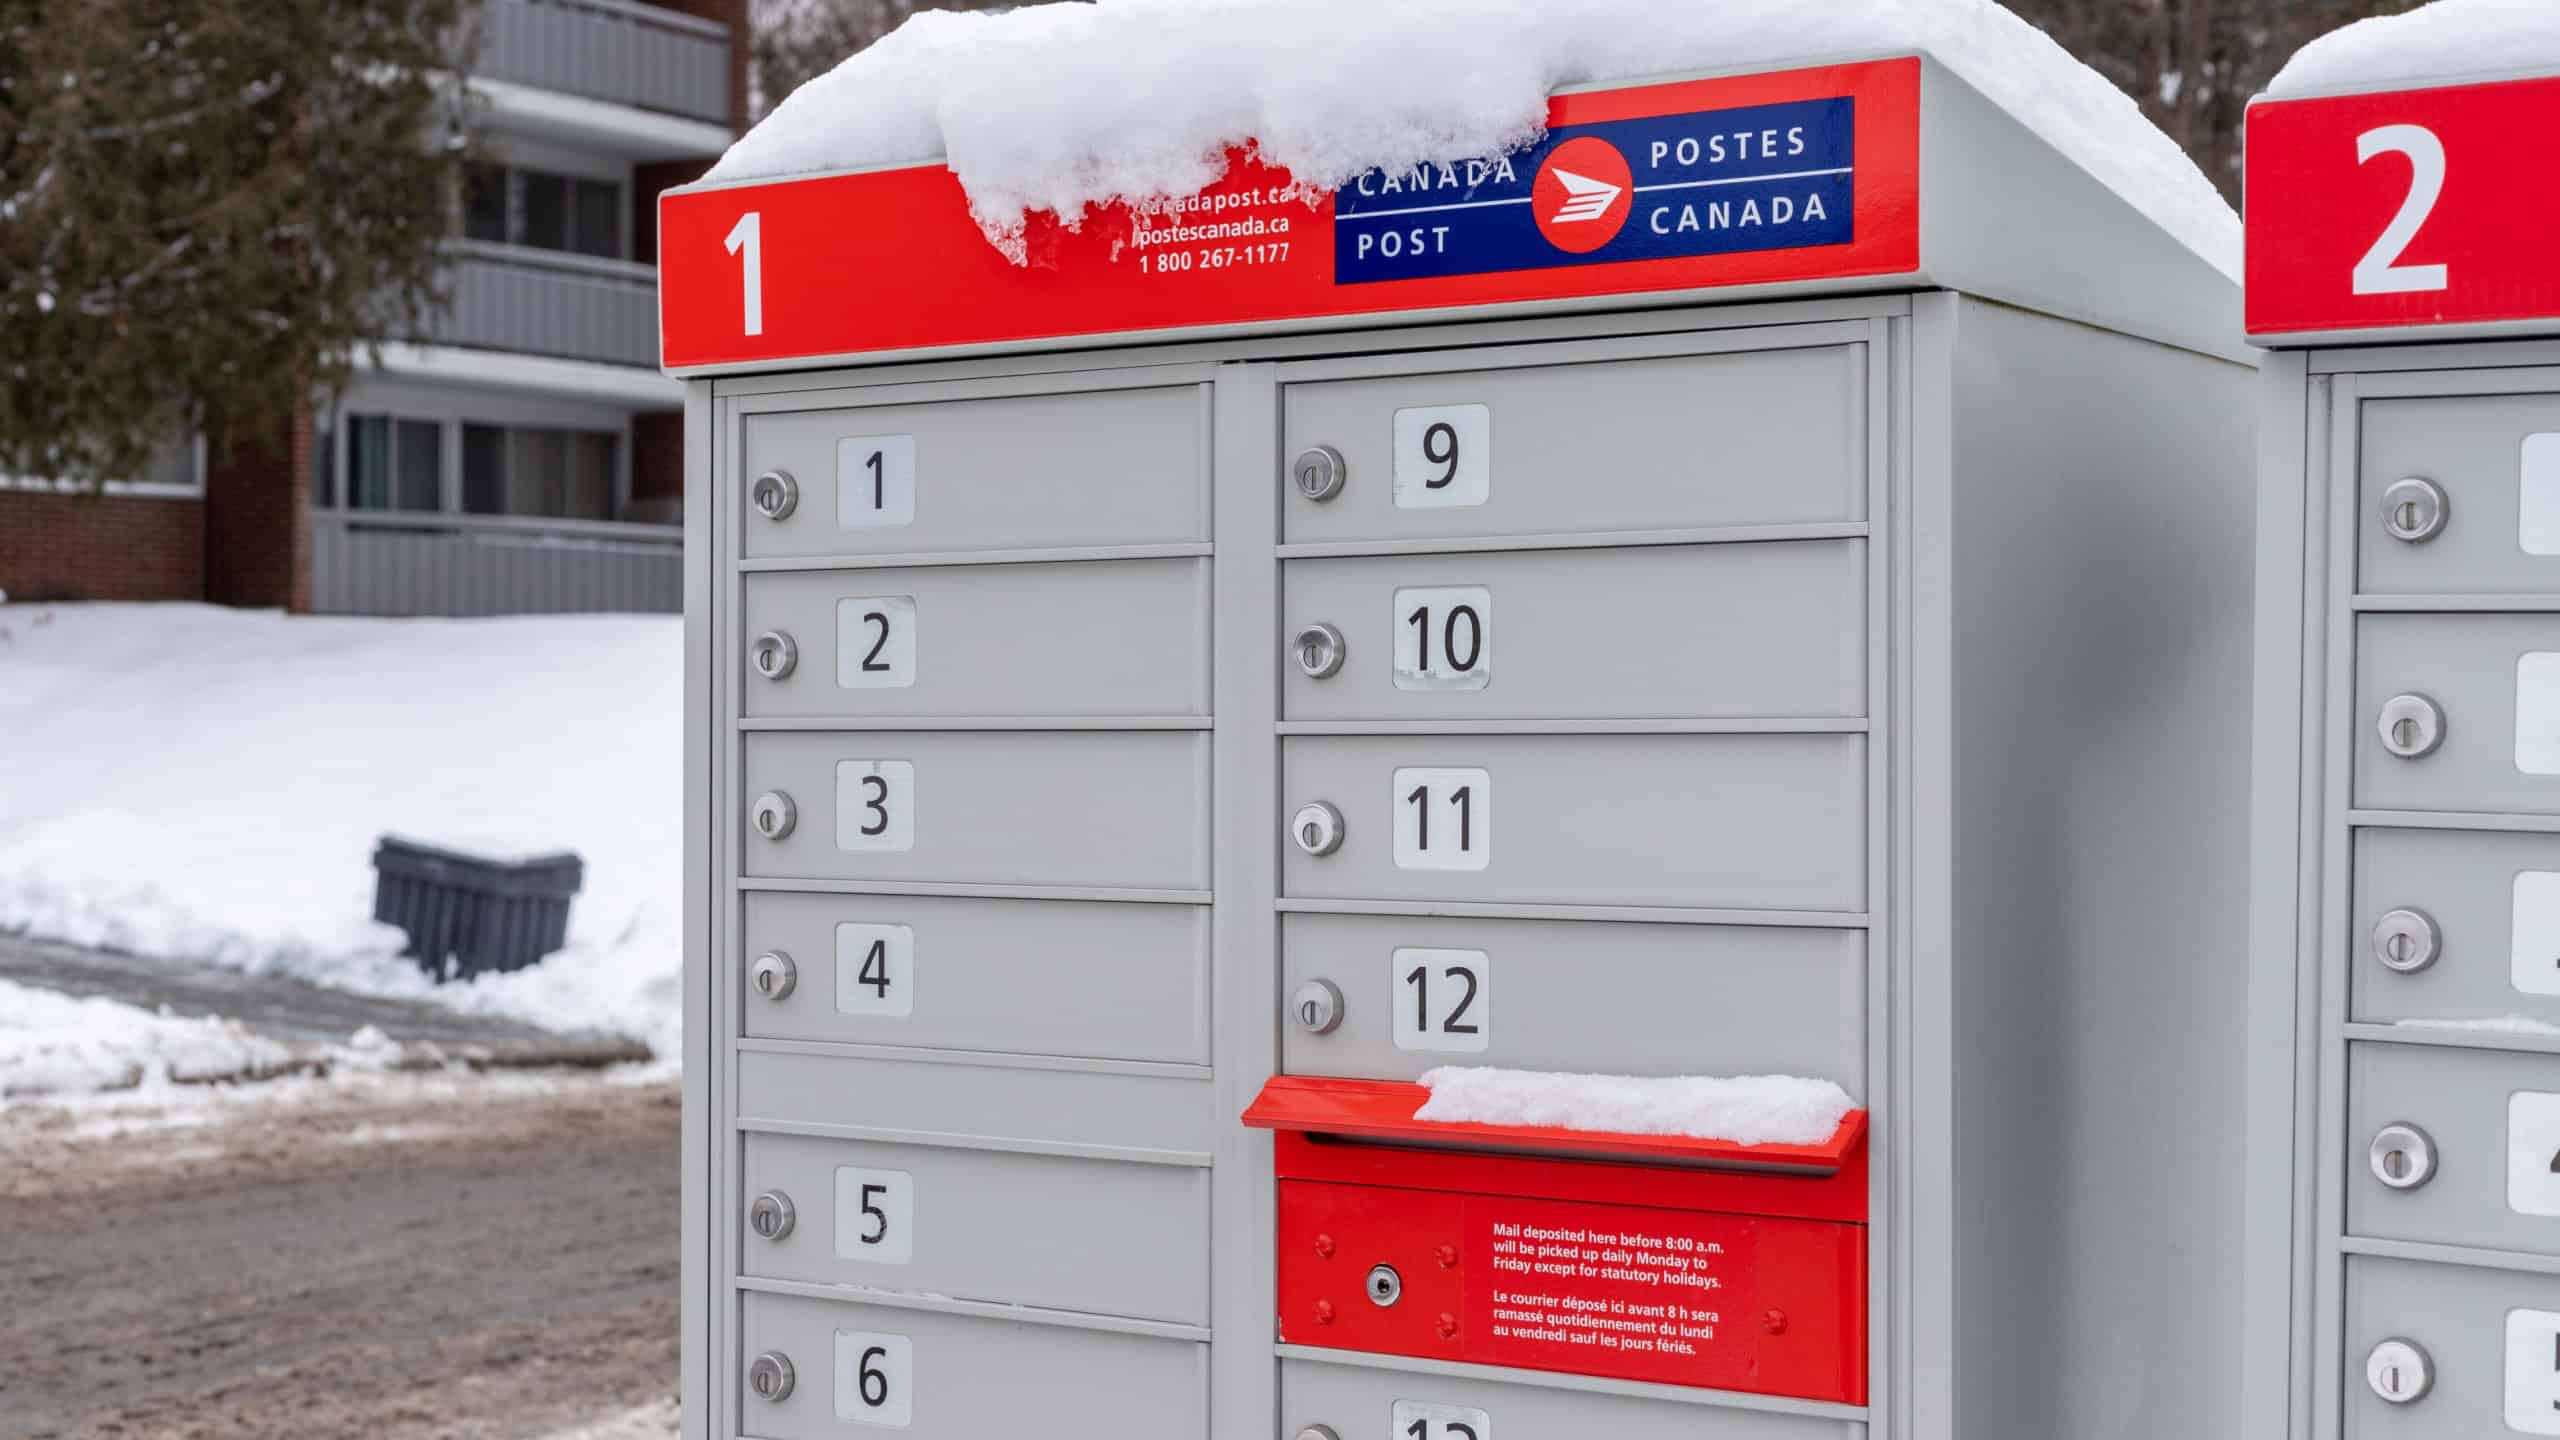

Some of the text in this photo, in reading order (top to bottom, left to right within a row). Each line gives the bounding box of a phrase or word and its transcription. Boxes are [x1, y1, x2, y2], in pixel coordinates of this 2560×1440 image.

[1651, 127, 1804, 169] POSTES
[1357, 158, 1517, 196] CANADA
[1140, 216, 1289, 250] postescanada.ca
[1650, 193, 1827, 234] CANADA
[2353, 124, 2448, 295] 2
[1140, 243, 1290, 274] 1 800 267-1177
[1358, 226, 1450, 260] POST
[724, 211, 763, 337] 1
[865, 451, 883, 510] 1
[1423, 422, 1459, 489] 9
[862, 612, 890, 672] 2
[1408, 604, 1481, 673] 10
[861, 775, 888, 836] 3
[1407, 785, 1470, 851] 11
[858, 939, 891, 999] 4
[1406, 966, 1479, 1034] 12
[860, 1183, 888, 1245] 5
[1494, 1224, 1723, 1253] Mail deposited here before 8:00 a.m.
[1494, 1241, 1707, 1271] will be picked up daily Monday to
[1494, 1258, 1721, 1289] Friday except for statutory holidays.
[1494, 1290, 1718, 1322] Le courrier déposé ici avant 8 h sera
[1494, 1309, 1712, 1339] ramassé quotidiennement du lundi
[1494, 1326, 1696, 1355] au vendredi sauf les jours fériés.
[859, 1346, 888, 1407] 6
